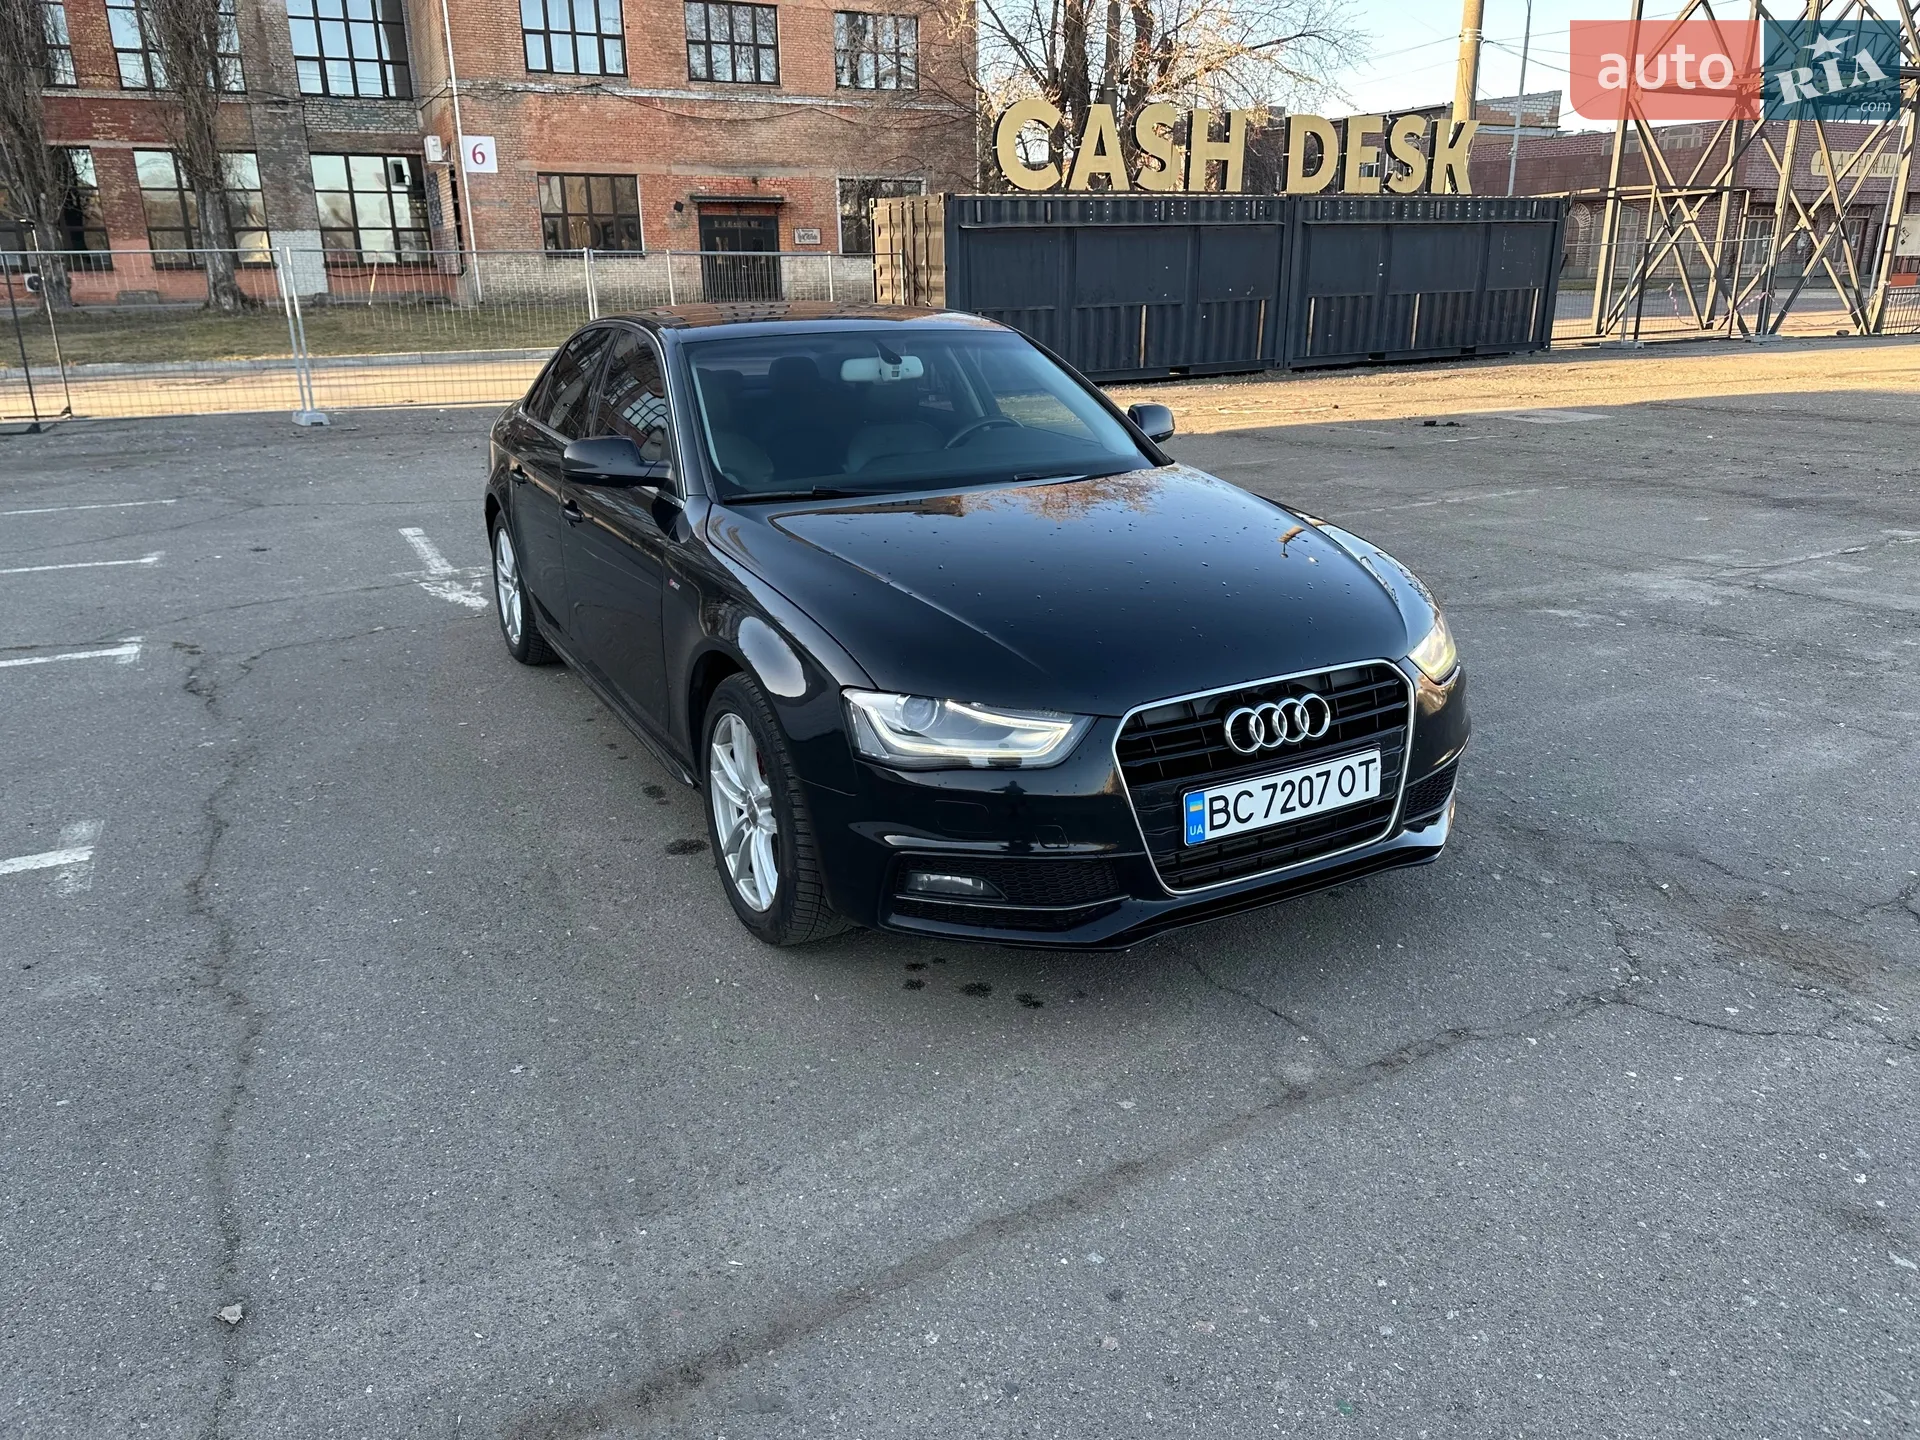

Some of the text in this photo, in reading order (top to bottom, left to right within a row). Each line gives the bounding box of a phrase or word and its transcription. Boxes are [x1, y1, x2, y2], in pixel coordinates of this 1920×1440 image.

[472, 142, 486, 165] 6
[992, 99, 1481, 194] CASH DESK
[1209, 757, 1376, 831] BC 7207 OT
[1190, 825, 1203, 836] UA
